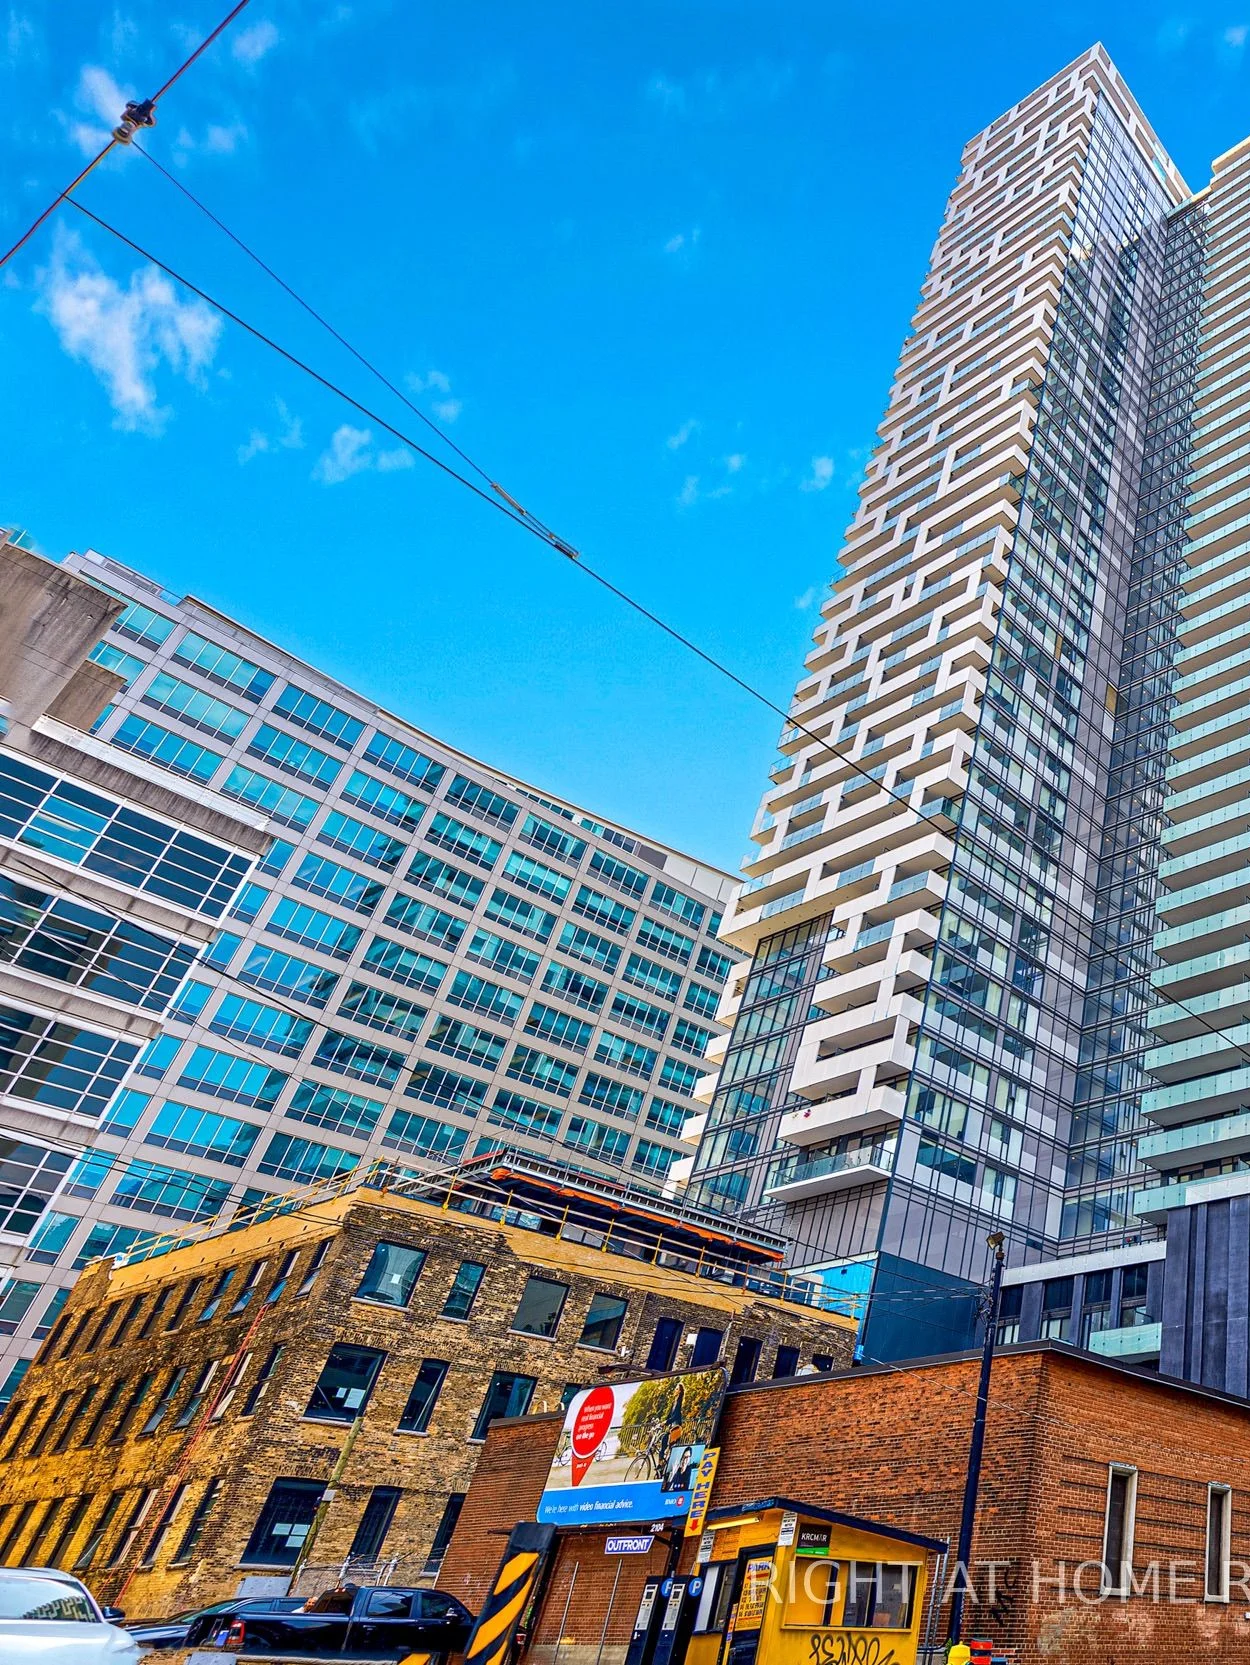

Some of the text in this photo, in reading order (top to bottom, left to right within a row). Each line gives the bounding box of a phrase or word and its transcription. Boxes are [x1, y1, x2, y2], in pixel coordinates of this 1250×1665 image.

[701, 1452, 717, 1477] PAY
[579, 1501, 593, 1512] video
[593, 1500, 616, 1510] financial
[690, 1481, 711, 1519] HERE
[607, 1539, 650, 1551] OUTFRONT
[692, 1580, 702, 1594] P
